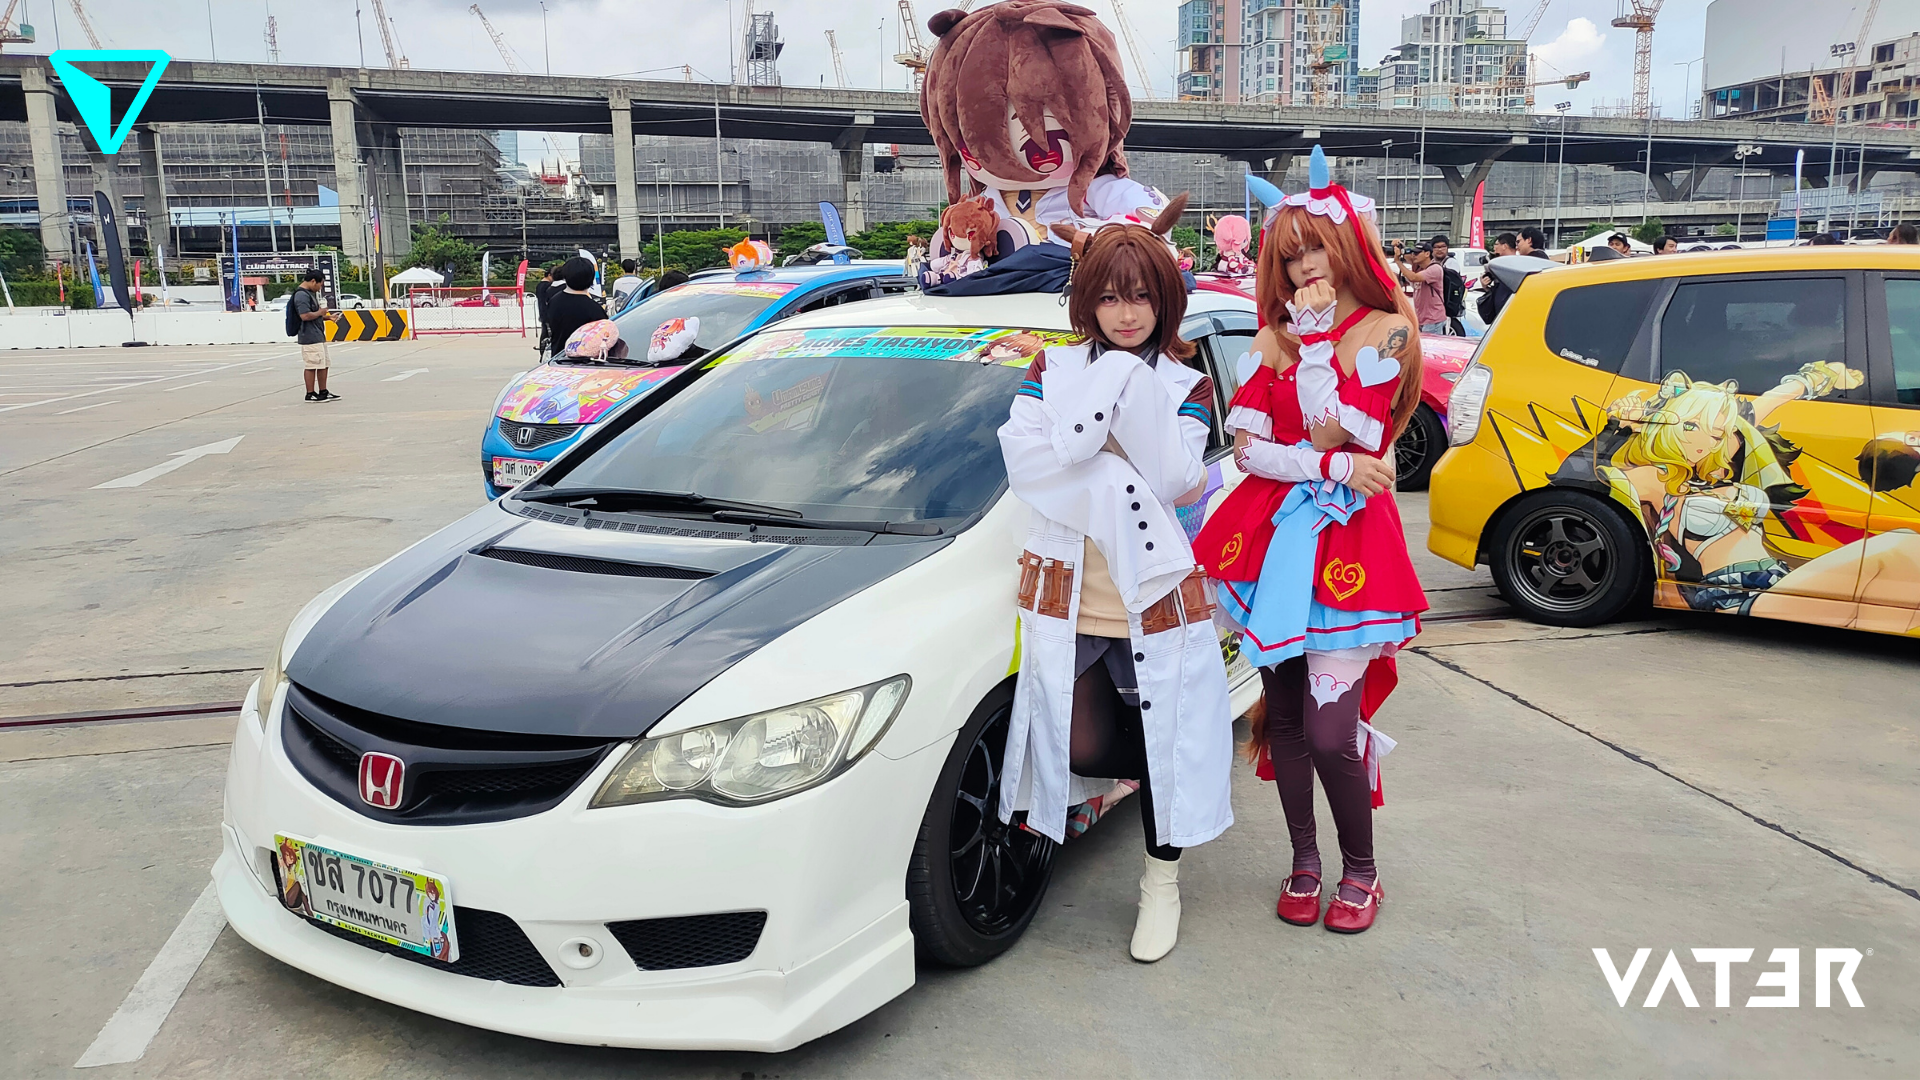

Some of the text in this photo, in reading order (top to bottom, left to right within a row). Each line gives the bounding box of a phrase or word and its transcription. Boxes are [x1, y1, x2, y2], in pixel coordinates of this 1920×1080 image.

[797, 337, 982, 351] AGNES TACHYON
[309, 851, 345, 894] ชส
[351, 863, 414, 914] 7077
[326, 899, 408, 935] กรุงเทพมหานคร
